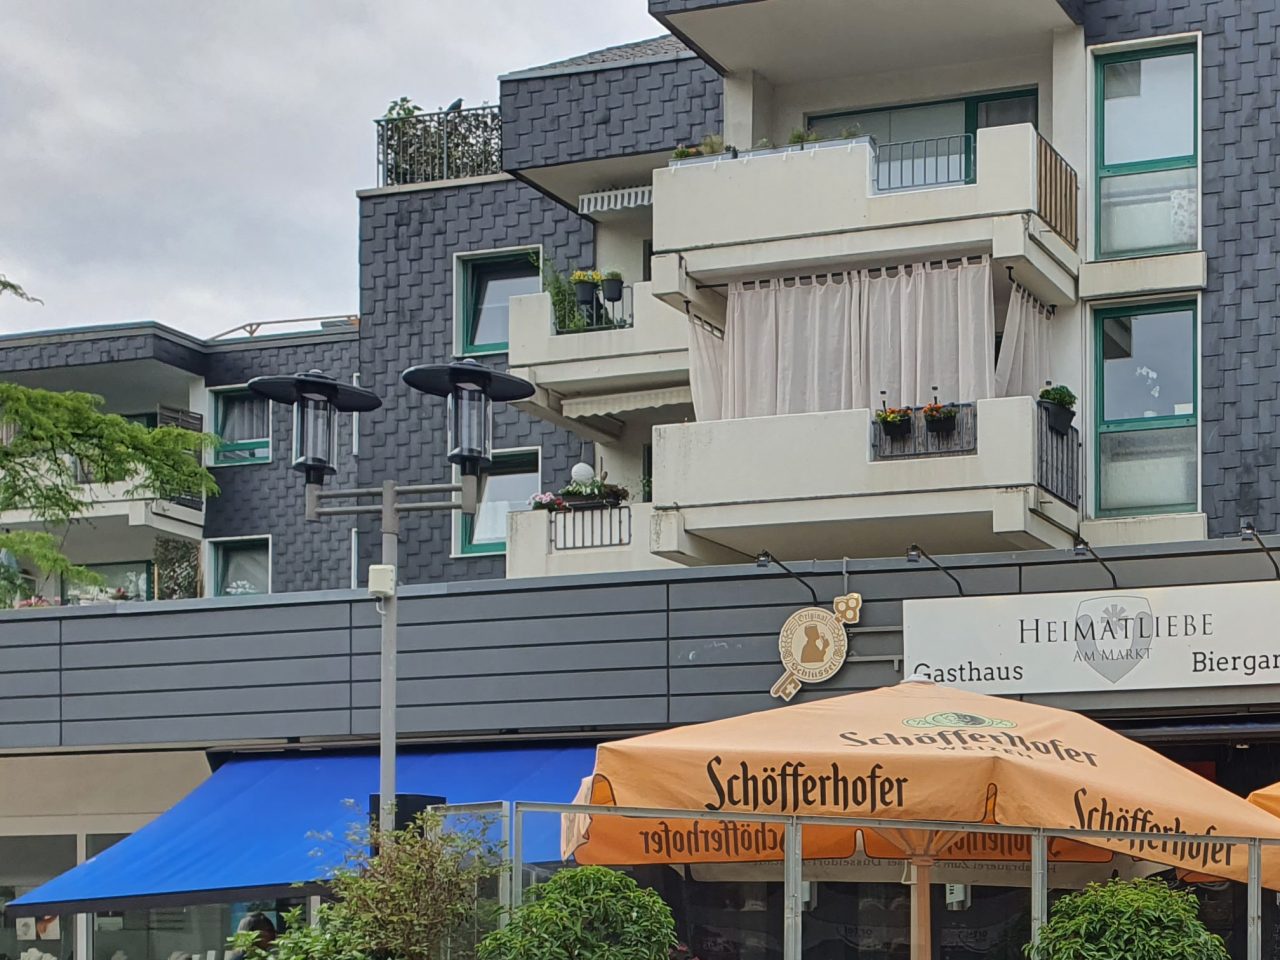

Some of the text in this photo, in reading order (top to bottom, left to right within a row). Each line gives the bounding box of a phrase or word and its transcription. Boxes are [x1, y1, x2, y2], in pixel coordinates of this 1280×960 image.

[797, 612, 828, 621] Original
[1018, 613, 1214, 644] HEIMATLIEBE
[1073, 647, 1152, 662] AM MARKT
[790, 660, 837, 678] Schlüssel
[914, 661, 1024, 683] Gasthaus
[839, 729, 1098, 767] Schöfferhofer
[704, 755, 908, 813] Schöfferhofer
